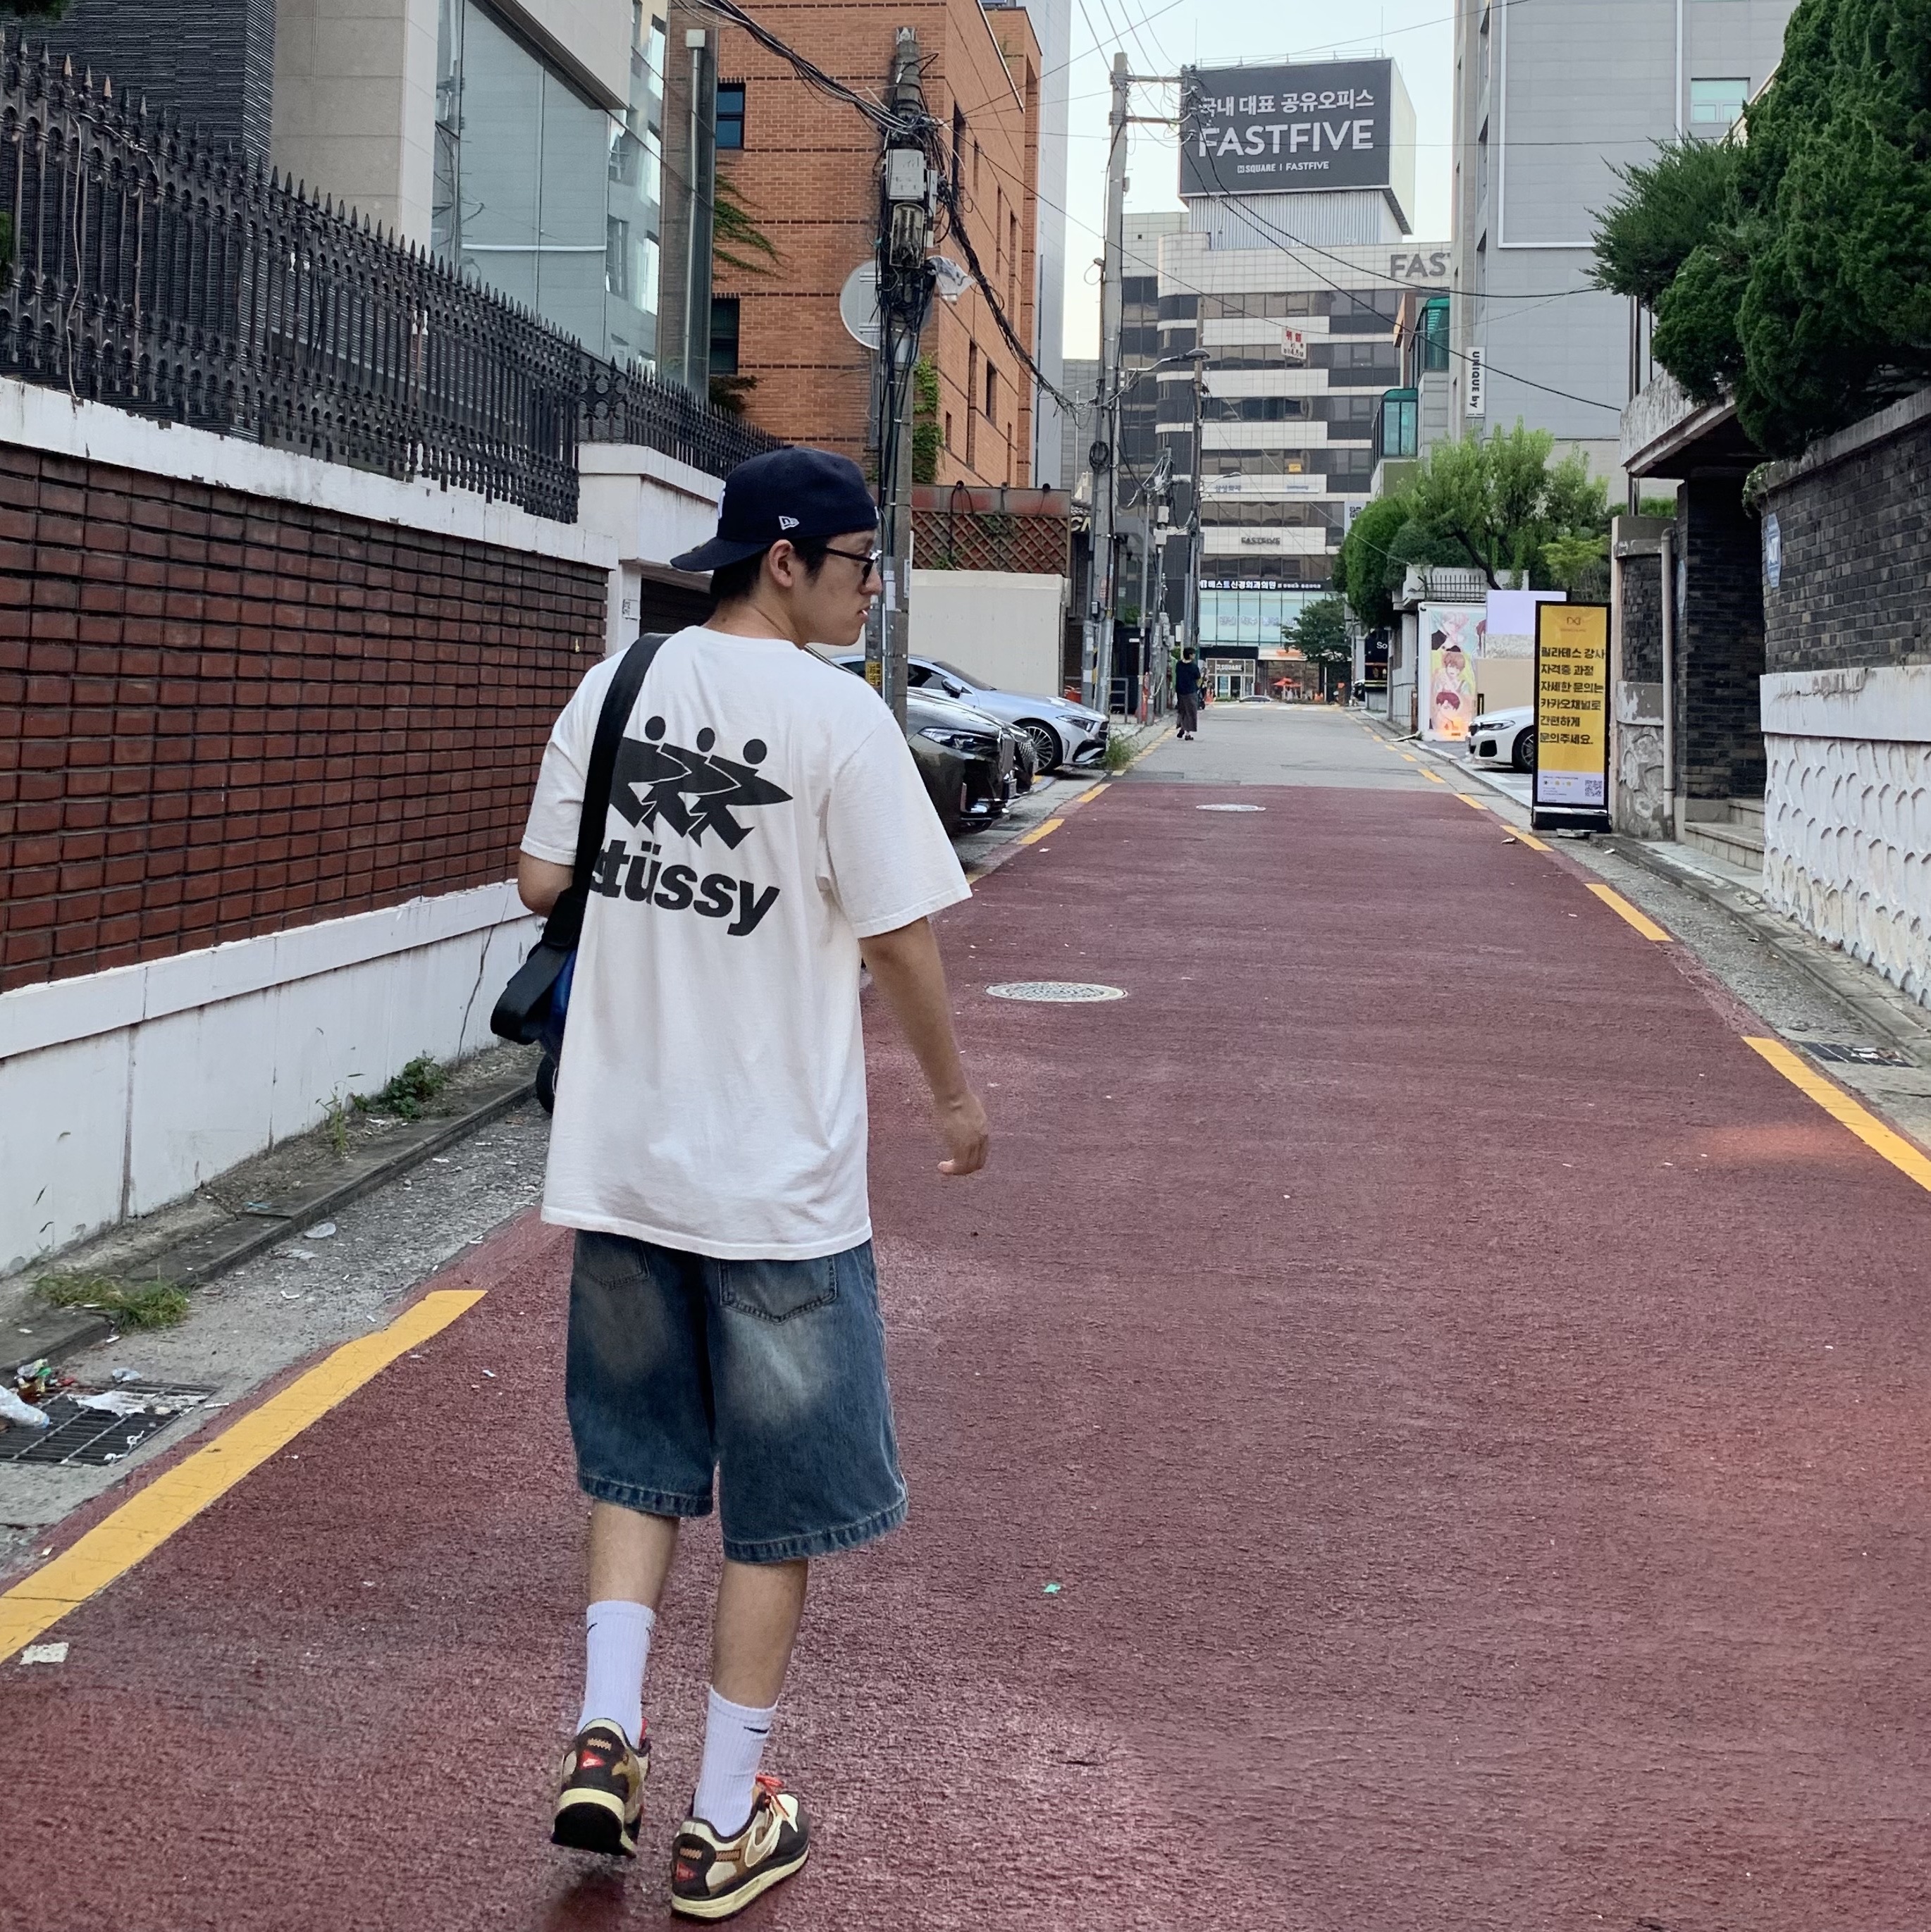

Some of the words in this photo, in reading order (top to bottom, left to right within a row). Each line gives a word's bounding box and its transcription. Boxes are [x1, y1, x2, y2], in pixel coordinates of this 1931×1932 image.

[1200, 96, 1234, 118] 국내
[1239, 95, 1276, 116] 대표
[1281, 89, 1374, 113] 공유오피스
[1199, 119, 1374, 157] FASTFIVE
[1285, 161, 1330, 171] FASTFIVE
[1390, 252, 1450, 278] FAS
[1472, 351, 1480, 392] UNIQUE
[1469, 395, 1480, 408] by
[1584, 648, 1605, 660] 강사
[1541, 664, 1571, 675] 자격증
[1541, 681, 1572, 693] 자세한
[1573, 682, 1604, 693] 문의는
[1541, 698, 1600, 711] 카카오채널로
[1540, 715, 1580, 727] 간편하게
[1539, 732, 1593, 745] 문의주세요.
